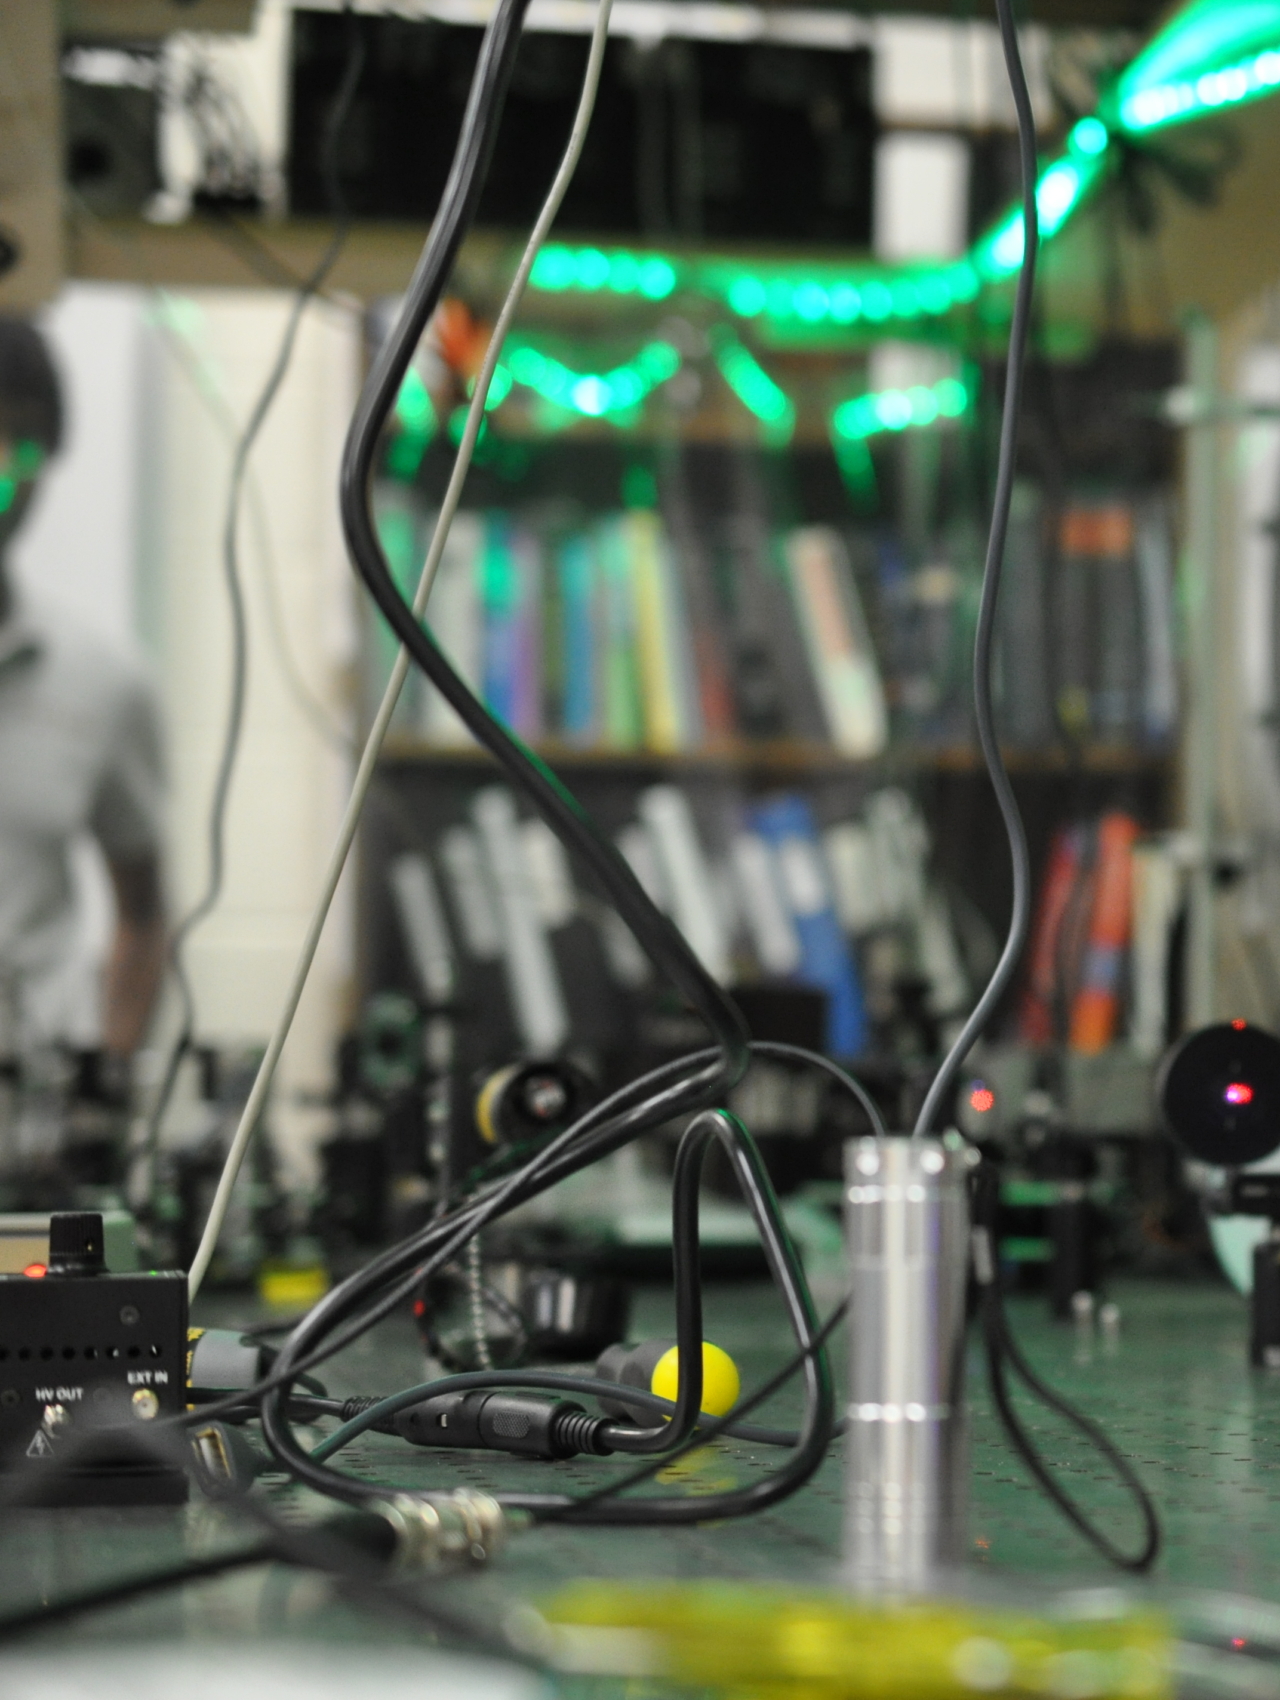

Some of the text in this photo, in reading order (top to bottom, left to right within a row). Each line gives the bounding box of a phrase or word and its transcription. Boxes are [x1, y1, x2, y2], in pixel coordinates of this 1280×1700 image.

[127, 1369, 168, 1385] EXT IN
[36, 1386, 84, 1401] HV OUT
